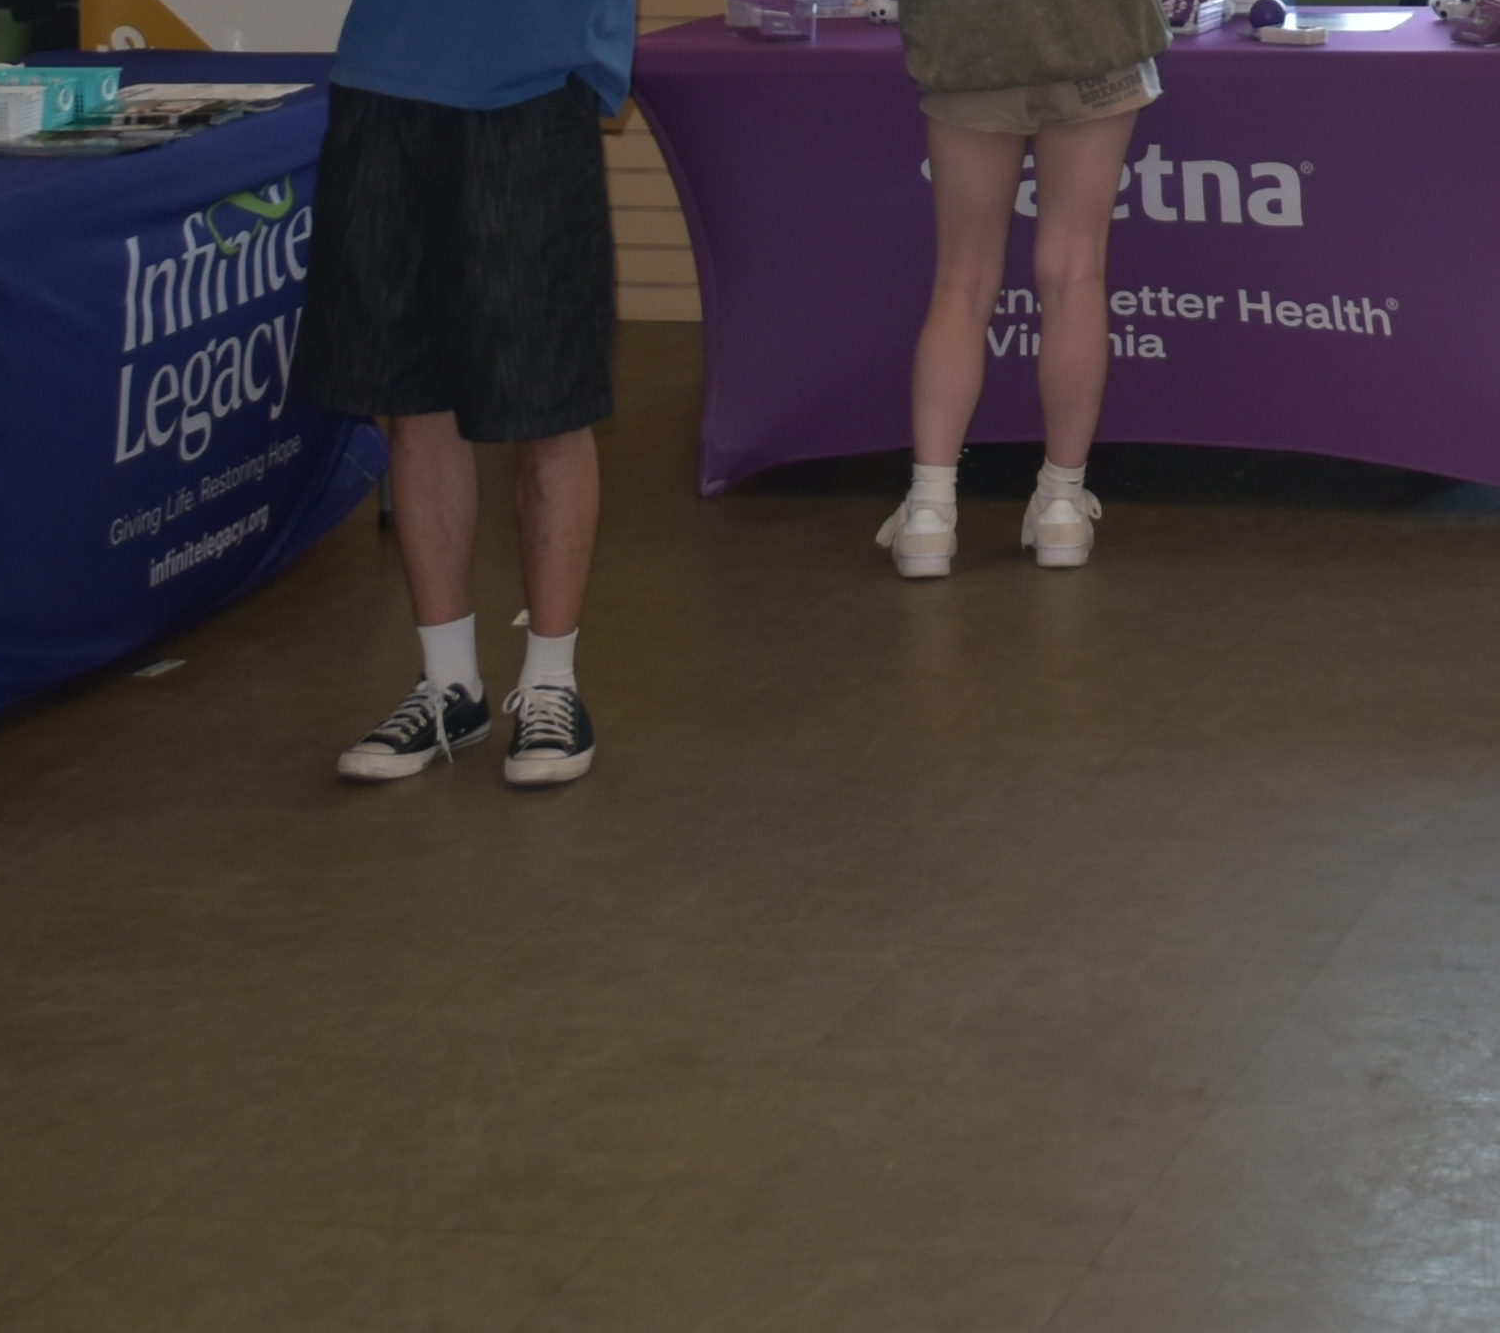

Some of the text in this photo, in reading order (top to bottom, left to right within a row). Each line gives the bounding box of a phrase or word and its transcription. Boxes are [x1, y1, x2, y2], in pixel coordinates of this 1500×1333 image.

[123, 182, 314, 353] Infinite
[1109, 285, 1225, 320] etter
[114, 307, 303, 463] Legacy
[110, 506, 162, 546] Giving
[165, 486, 197, 521] Life.
[201, 454, 265, 503] Restoring
[149, 503, 269, 588] infinitelegacy.org
